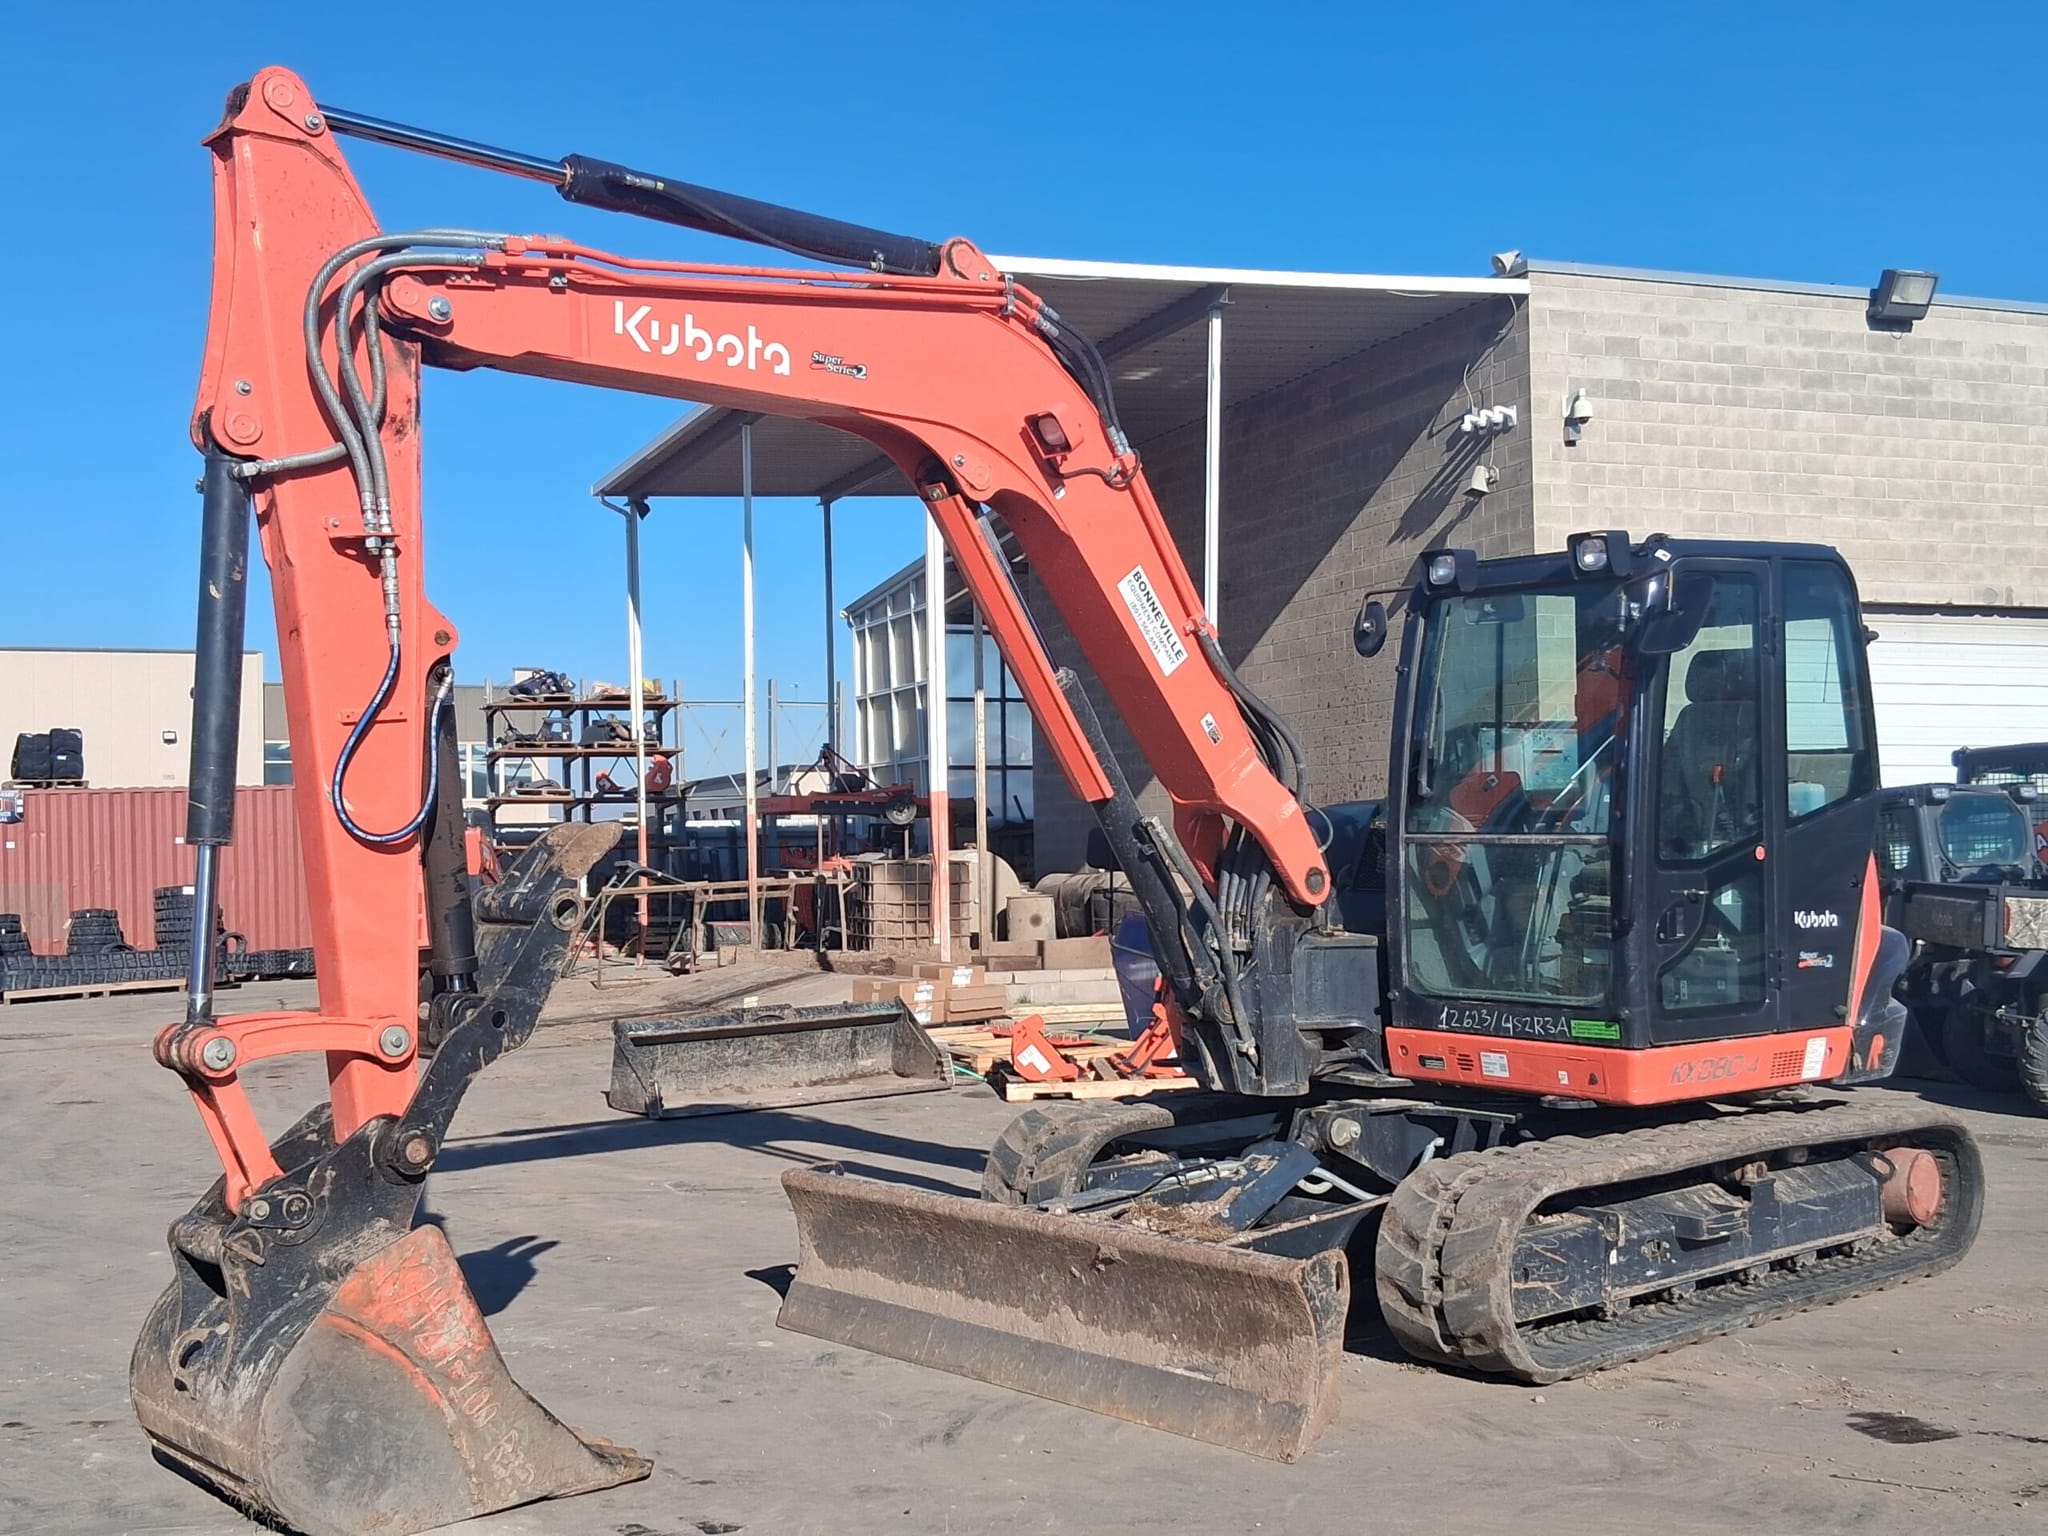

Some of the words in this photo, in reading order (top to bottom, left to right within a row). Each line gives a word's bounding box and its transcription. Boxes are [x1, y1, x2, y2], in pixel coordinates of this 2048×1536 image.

[614, 299, 790, 376] Kubota
[811, 351, 843, 365] Super
[1127, 579, 1156, 625] EQUIPMENT
[1152, 625, 1177, 665] COMPANY
[1132, 570, 1185, 661] BONNEVILLE
[1793, 909, 1839, 929] Kubota
